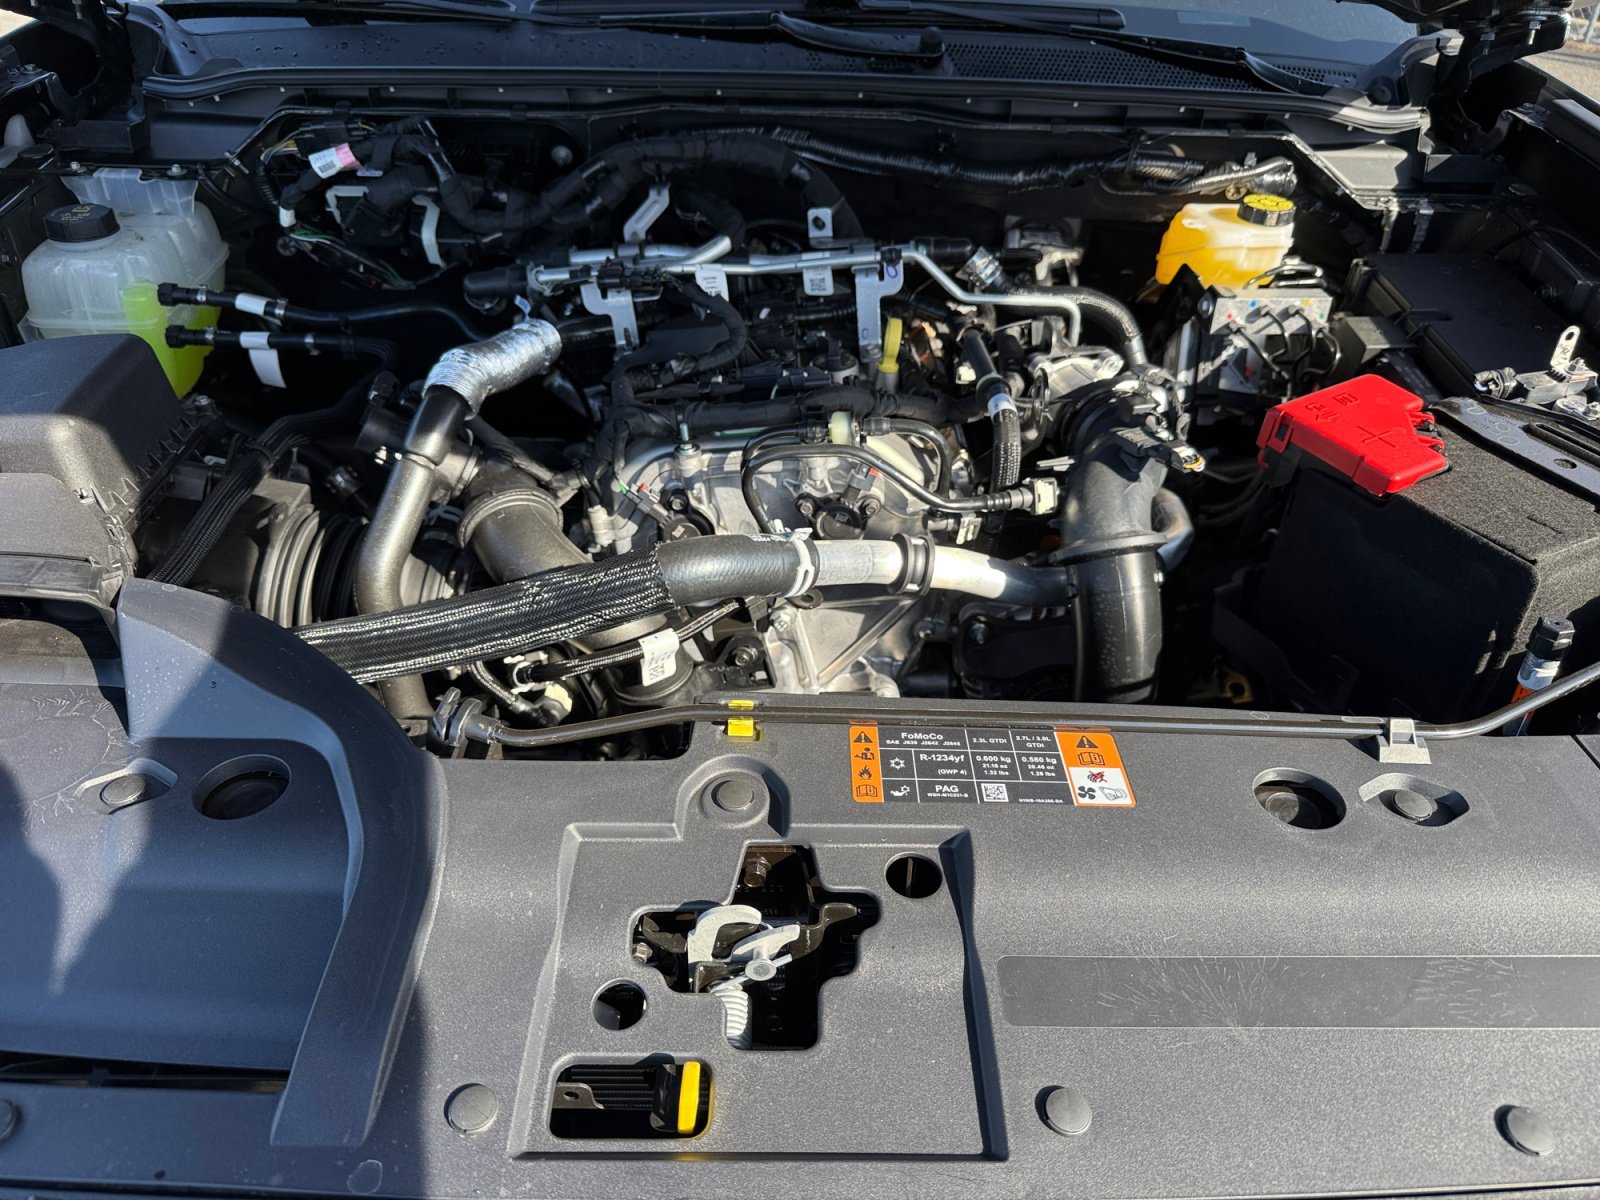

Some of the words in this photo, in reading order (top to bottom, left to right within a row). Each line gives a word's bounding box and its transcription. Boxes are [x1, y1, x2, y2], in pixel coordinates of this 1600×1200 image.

[901, 732, 943, 740] FoMoCo
[920, 753, 965, 764] R-1234yf
[1000, 755, 1011, 763] kg
[1045, 756, 1057, 765] kg
[937, 768, 959, 776] (GWP
[935, 784, 959, 793] PAG
